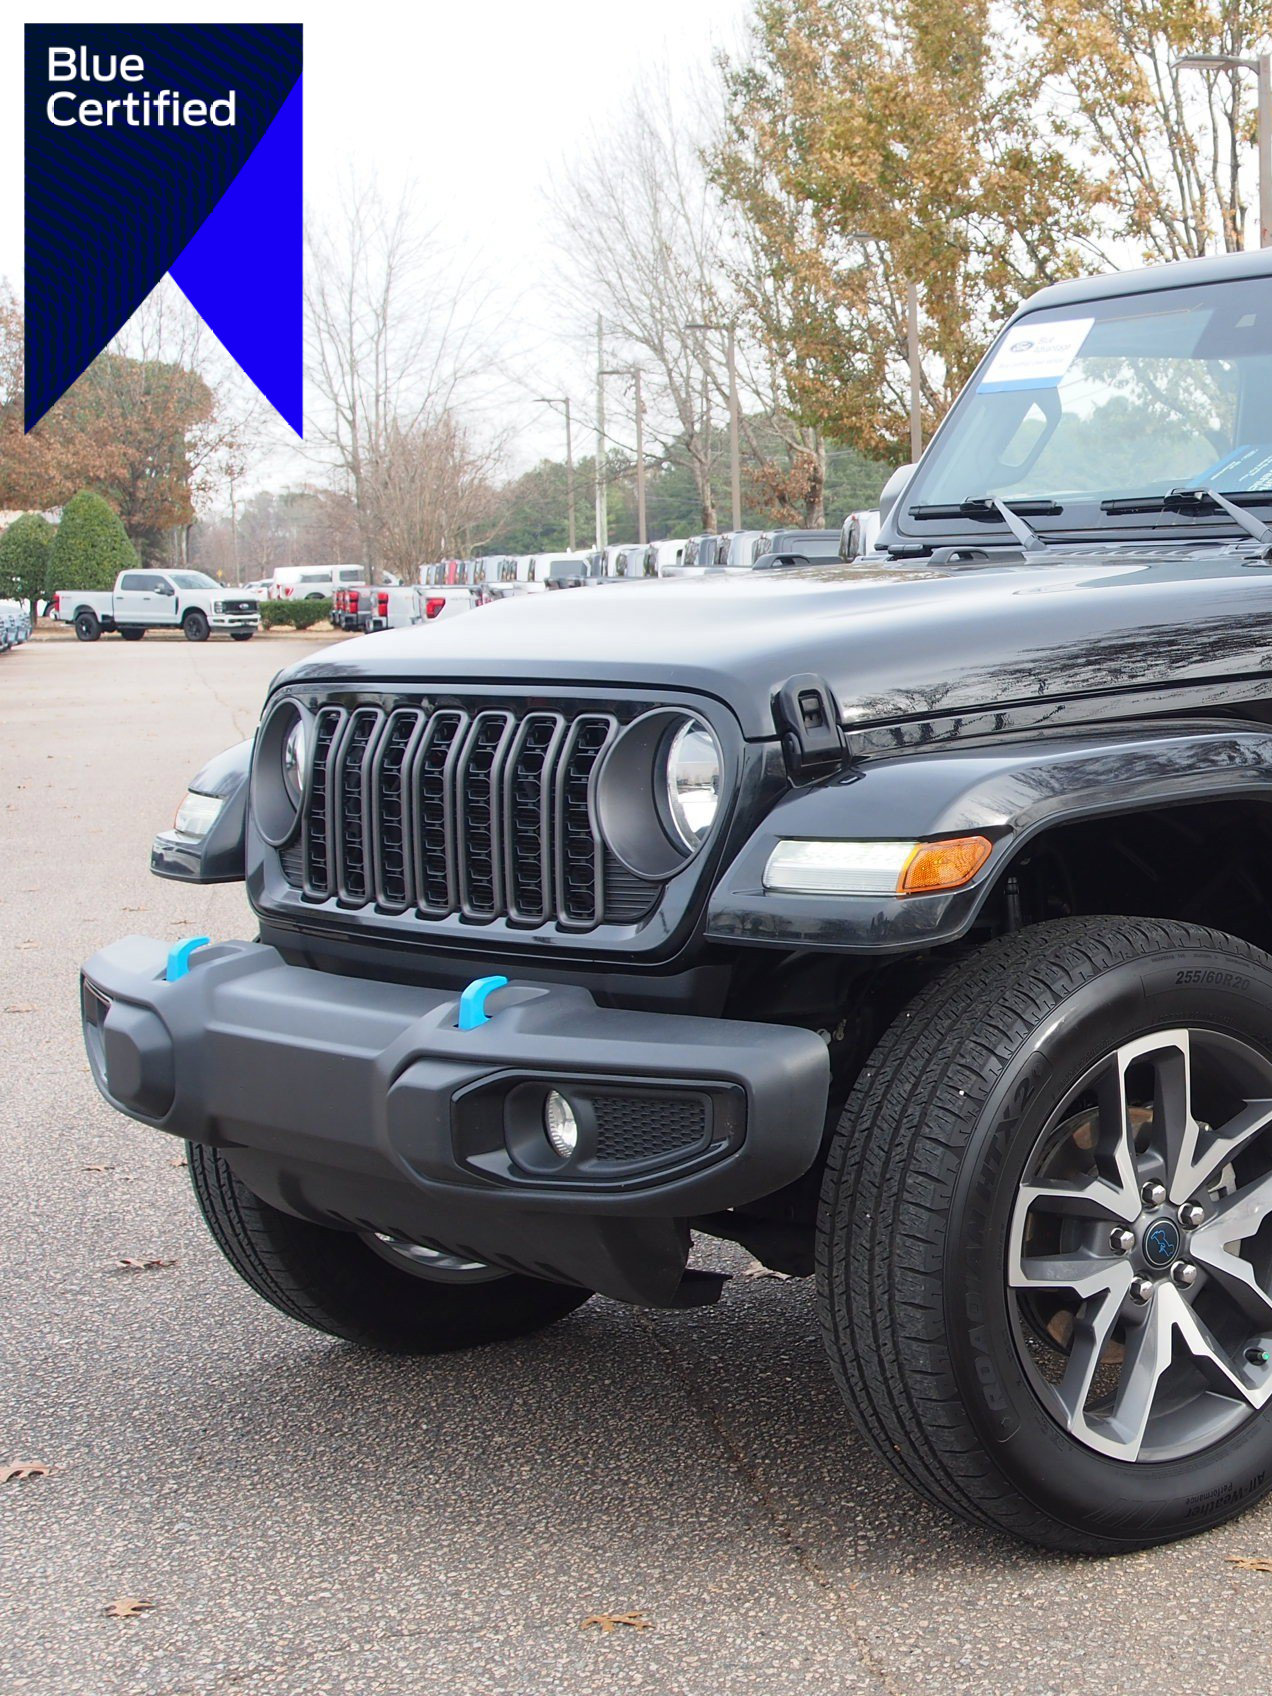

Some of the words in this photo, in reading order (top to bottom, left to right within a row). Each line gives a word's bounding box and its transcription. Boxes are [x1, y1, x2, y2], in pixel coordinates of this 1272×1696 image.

[1175, 970, 1251, 991] 255/60R20
[1184, 1471, 1266, 1519] All-Weather
[1185, 1482, 1233, 1505] Performance
